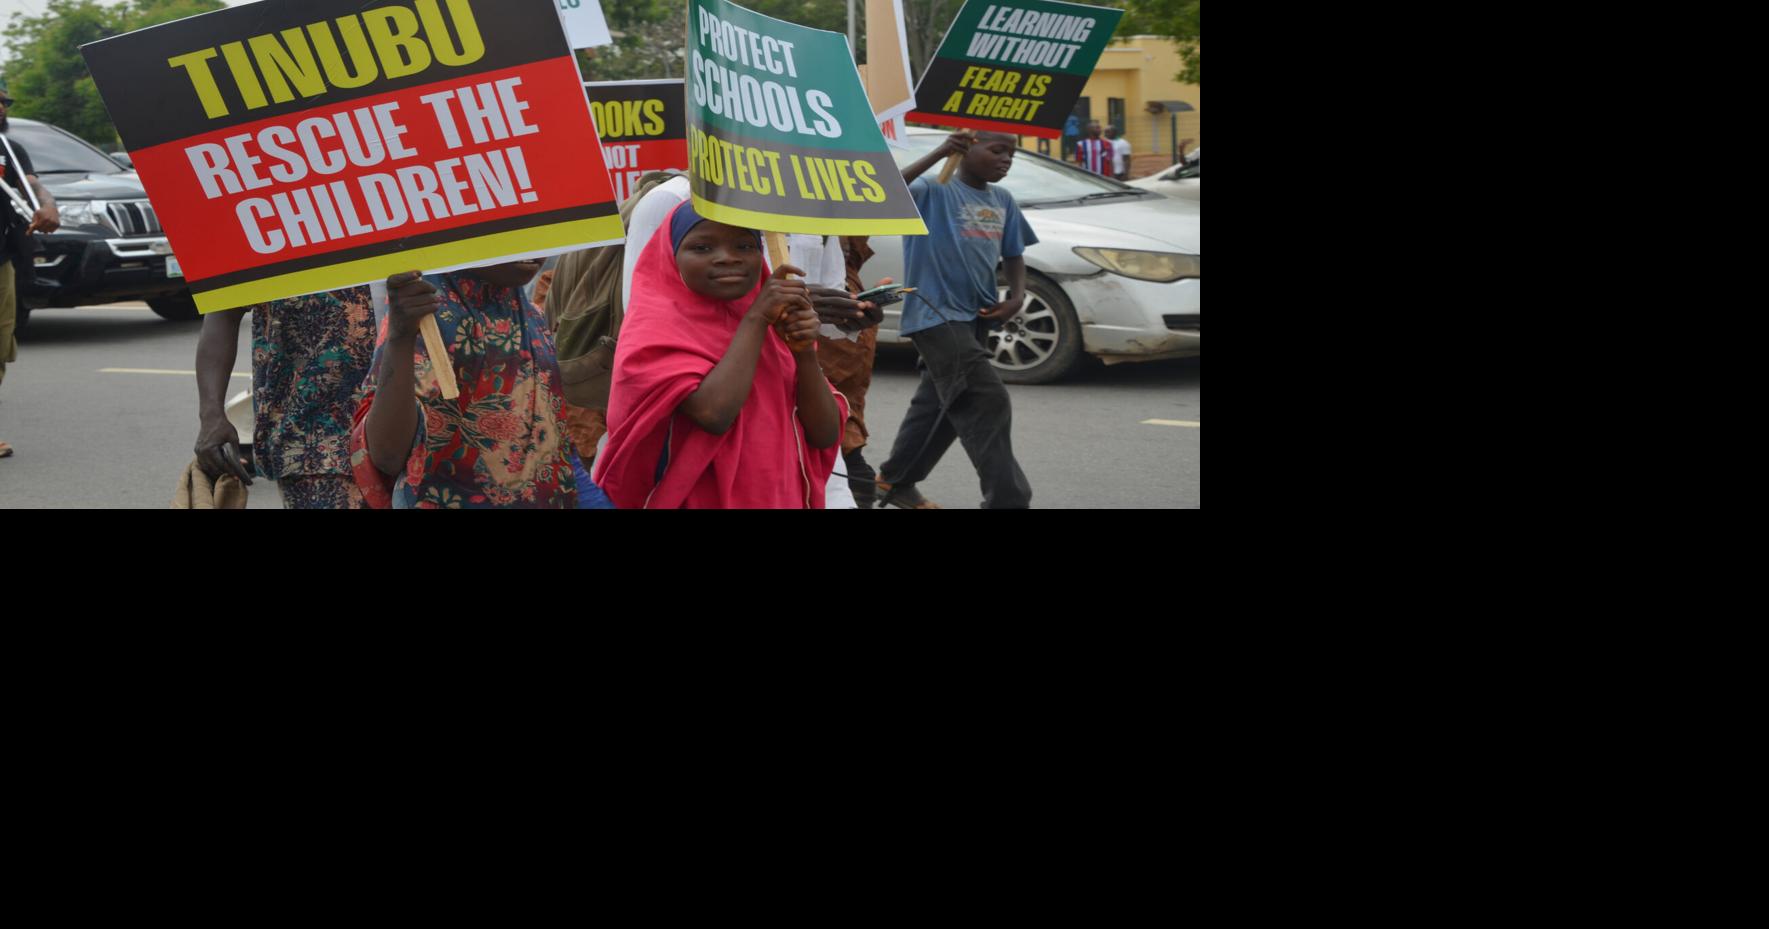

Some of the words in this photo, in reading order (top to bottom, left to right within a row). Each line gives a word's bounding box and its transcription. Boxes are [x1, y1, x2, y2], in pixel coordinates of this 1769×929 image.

[168, 0, 486, 119] TINUBU
[698, 4, 798, 78] PROTECT
[966, 31, 1082, 69] WITHOUT
[977, 5, 1095, 42] LEARNING
[692, 48, 842, 138] SCHOOLS
[943, 91, 964, 112] A
[966, 94, 1044, 121] RIGHT
[958, 65, 1022, 94] FEAR
[1022, 75, 1052, 97] IS
[185, 101, 418, 199] RESCUE
[420, 76, 539, 150] THE
[690, 124, 786, 197] PROTECT
[789, 154, 887, 203] LIVES
[235, 146, 540, 254] CHILDREN!
